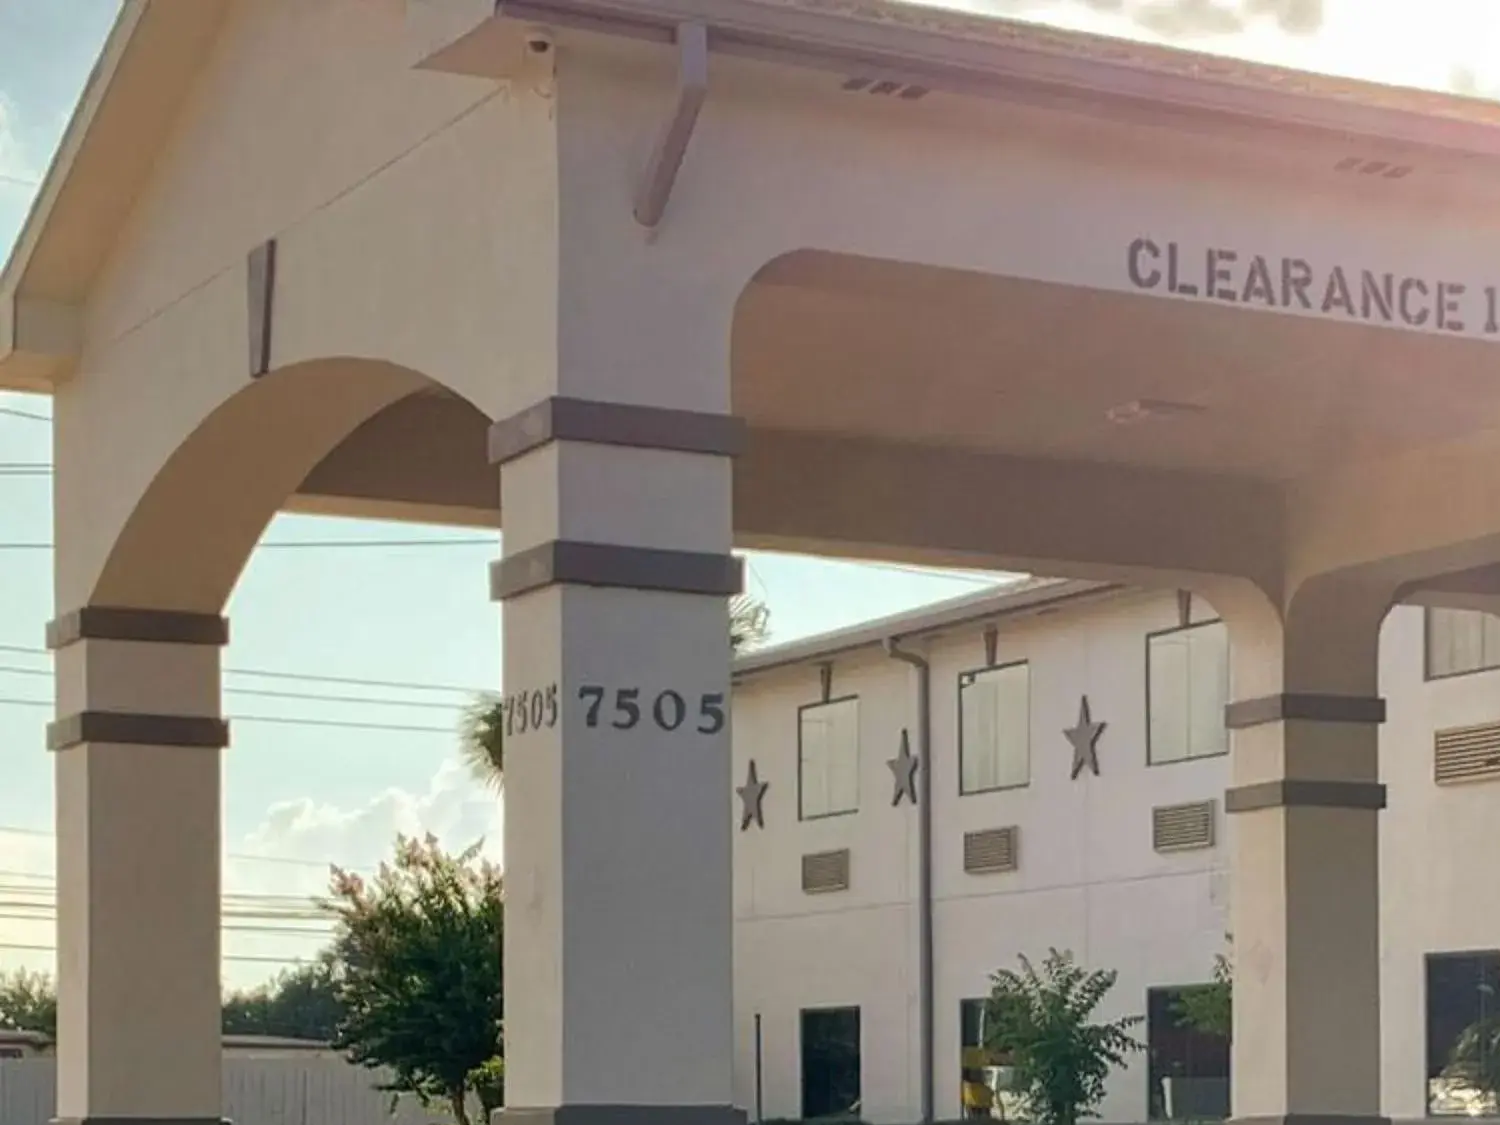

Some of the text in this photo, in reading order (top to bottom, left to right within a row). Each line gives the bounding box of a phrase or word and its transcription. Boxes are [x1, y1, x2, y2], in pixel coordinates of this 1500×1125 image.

[1127, 237, 1466, 332] CLEARANCE
[503, 681, 558, 737] 7505
[577, 685, 725, 735] 7505
